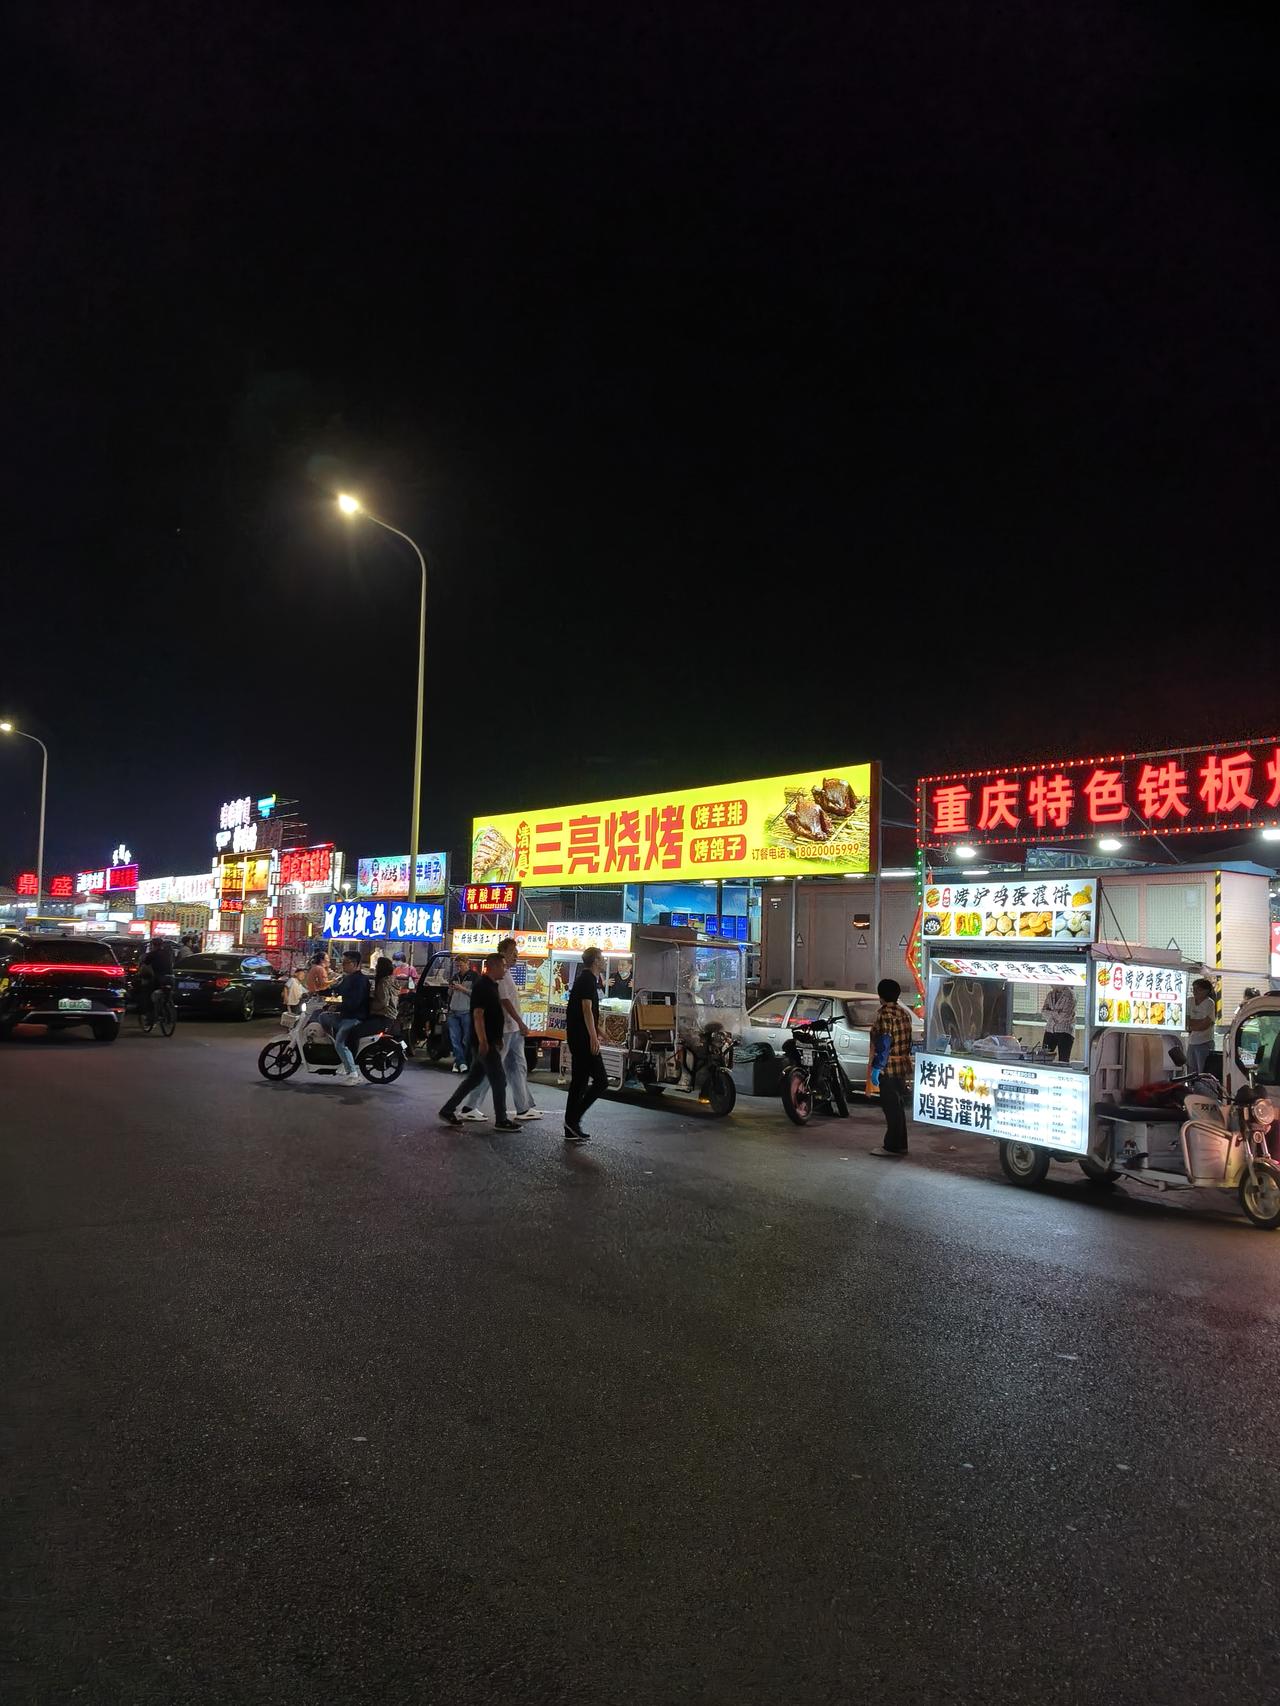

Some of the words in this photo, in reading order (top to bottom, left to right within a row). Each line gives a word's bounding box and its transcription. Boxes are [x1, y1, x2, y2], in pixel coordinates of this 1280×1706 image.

[931, 746, 1280, 835] 重庆特色铁板
[695, 801, 742, 828] 烤羊排
[515, 825, 531, 871] 清真
[532, 804, 685, 875] 三亮烧烤
[693, 836, 742, 862] 烤鸽子
[796, 843, 860, 859] 18020005999
[467, 887, 514, 904] 精酿啤酒
[953, 883, 1072, 908] 烤炉鸡蛋灌饼
[919, 1059, 955, 1090] 烤炉
[918, 1091, 993, 1131] 鸡蛋灌饼
